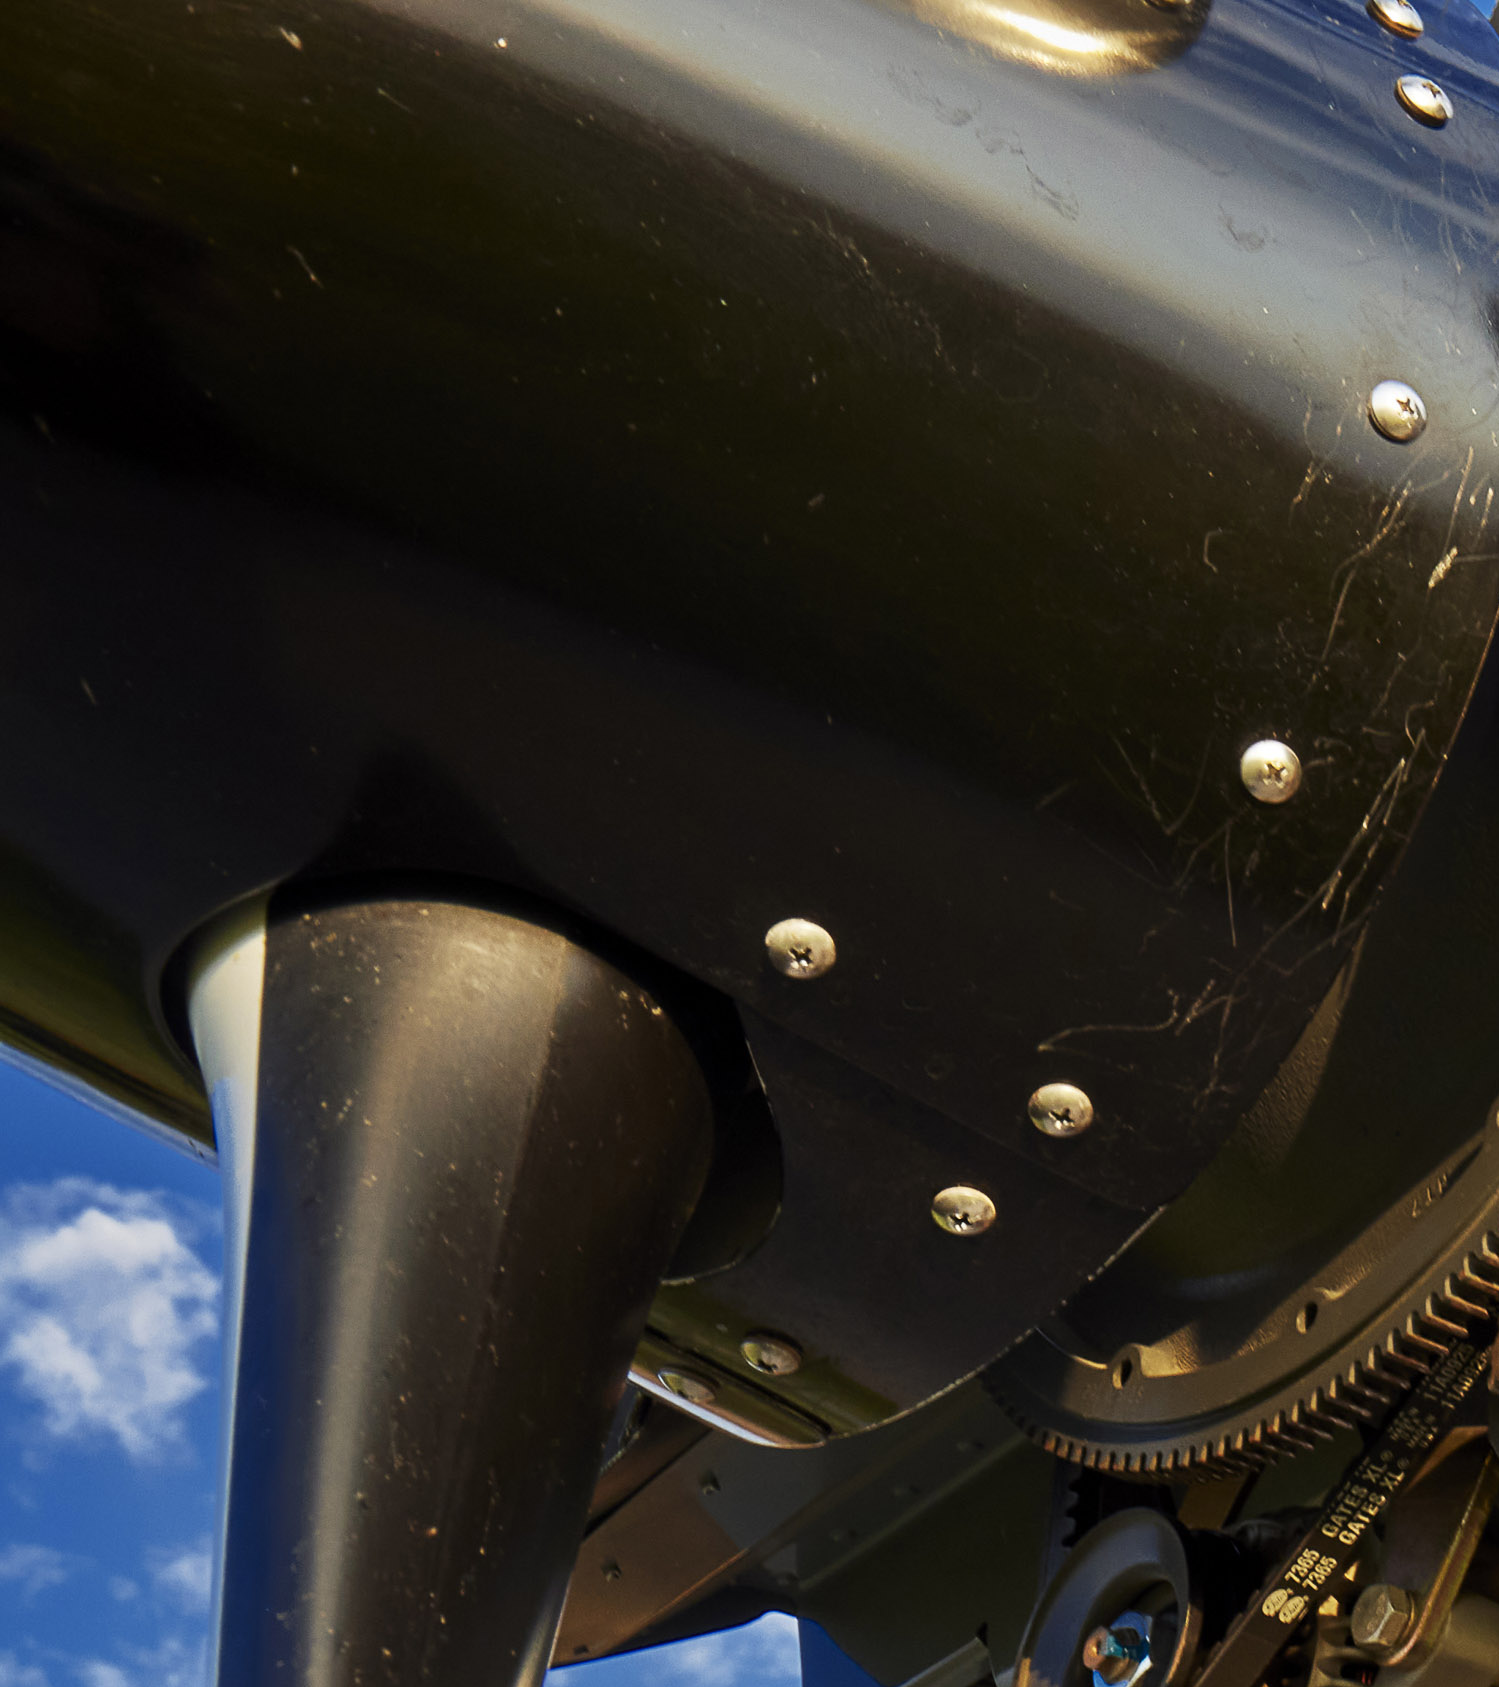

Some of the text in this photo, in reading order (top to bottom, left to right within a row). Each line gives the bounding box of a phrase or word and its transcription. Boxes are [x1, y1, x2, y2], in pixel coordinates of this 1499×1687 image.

[1284, 1547, 1323, 1585] 7365
[1320, 1484, 1371, 1541] GATES
[1301, 1554, 1338, 1591] 7365
[1337, 1490, 1387, 1547] GATES
